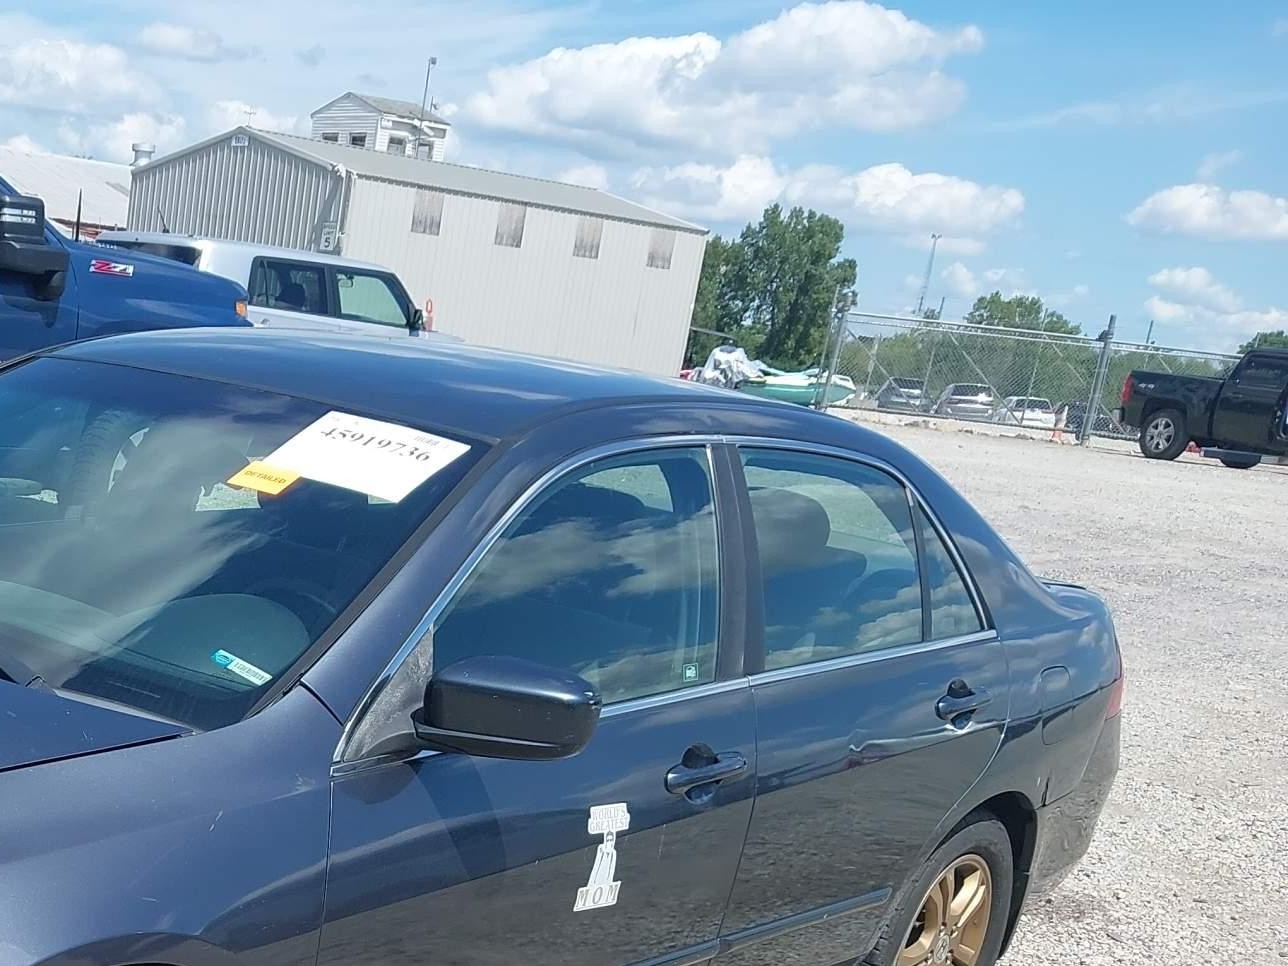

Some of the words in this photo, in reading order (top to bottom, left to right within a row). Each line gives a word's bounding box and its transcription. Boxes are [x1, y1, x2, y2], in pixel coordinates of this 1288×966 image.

[324, 236, 331, 248] 5
[320, 427, 431, 461] 45919736
[244, 470, 287, 484] DETAILED
[576, 884, 620, 908] MOM
